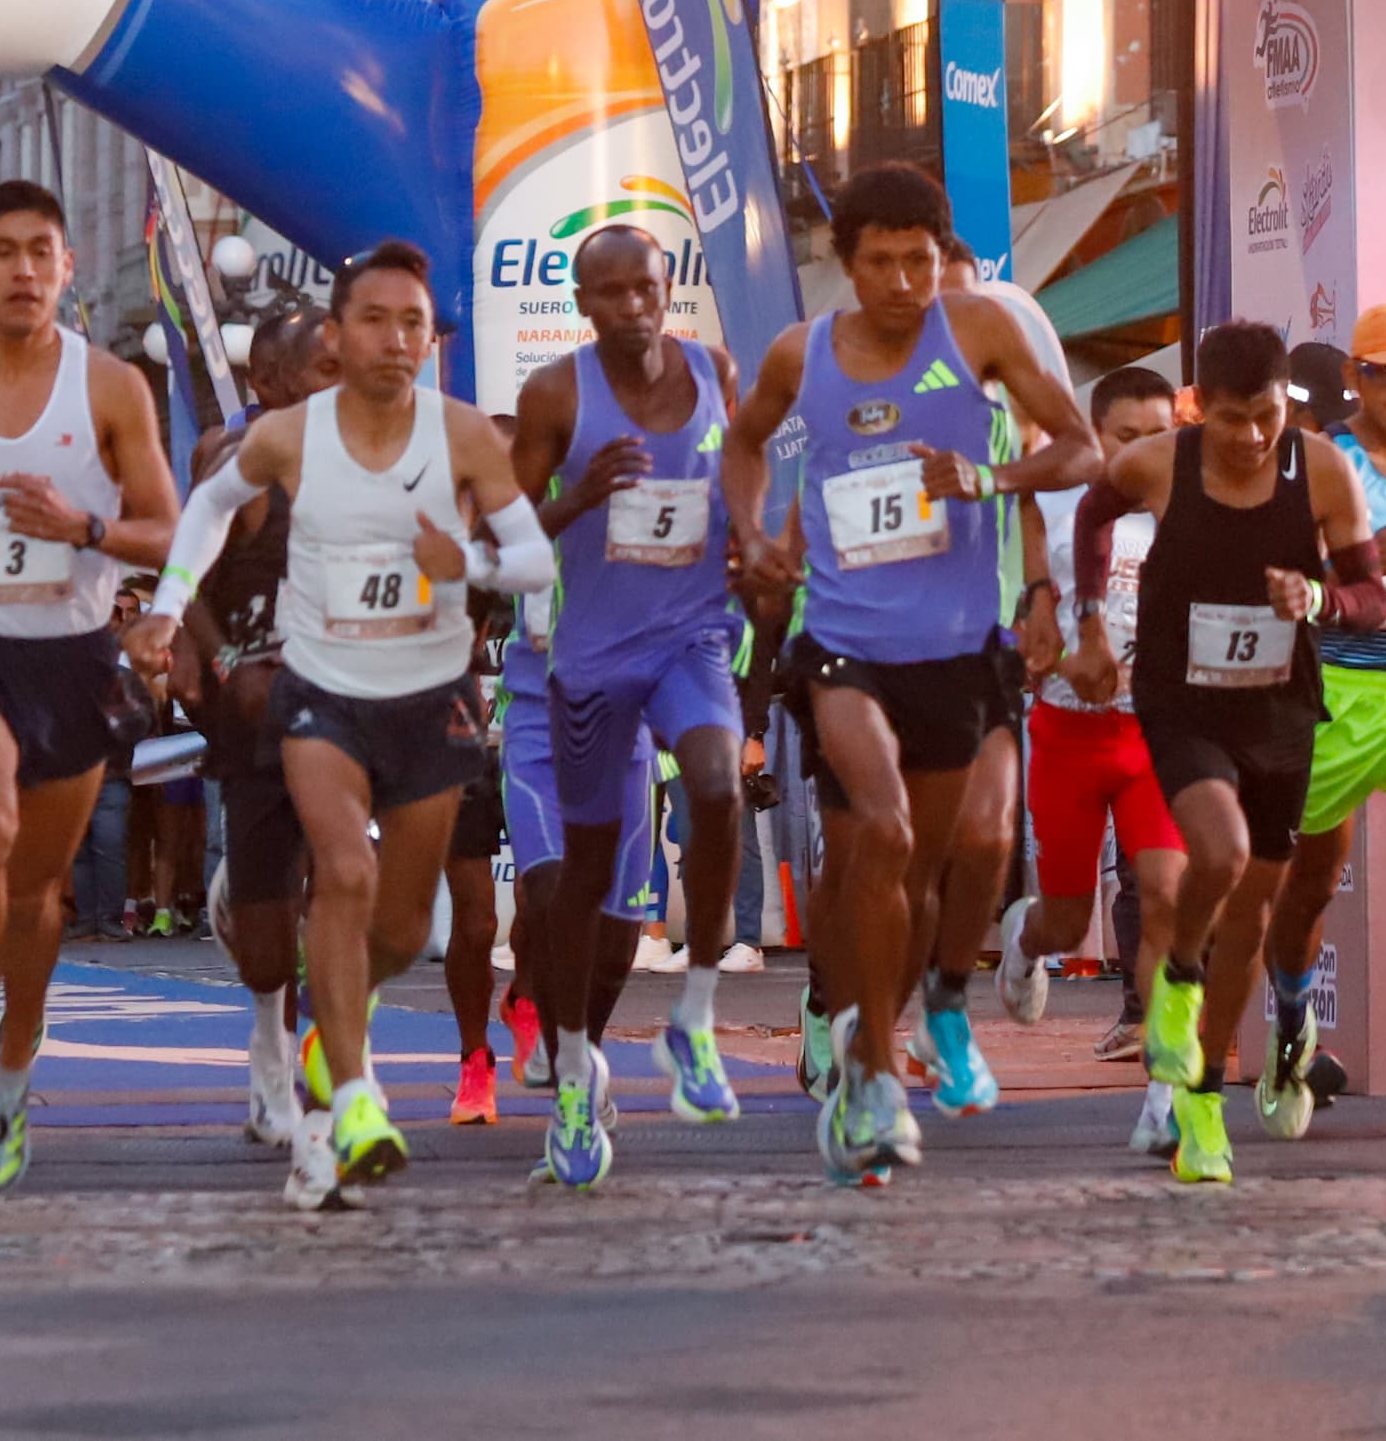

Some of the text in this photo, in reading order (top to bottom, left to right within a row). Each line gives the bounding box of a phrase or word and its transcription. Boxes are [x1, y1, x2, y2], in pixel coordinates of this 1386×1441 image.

[1266, 36, 1300, 78] FMAA
[945, 60, 1001, 108] Comex
[1248, 203, 1289, 236] Electrolit
[519, 301, 574, 315] SUERO
[517, 329, 593, 344] NARANJA
[654, 505, 676, 540] 5
[869, 493, 903, 534] 15
[4, 540, 27, 575] 3
[360, 572, 403, 610] 48
[1225, 630, 1259, 662] 13
